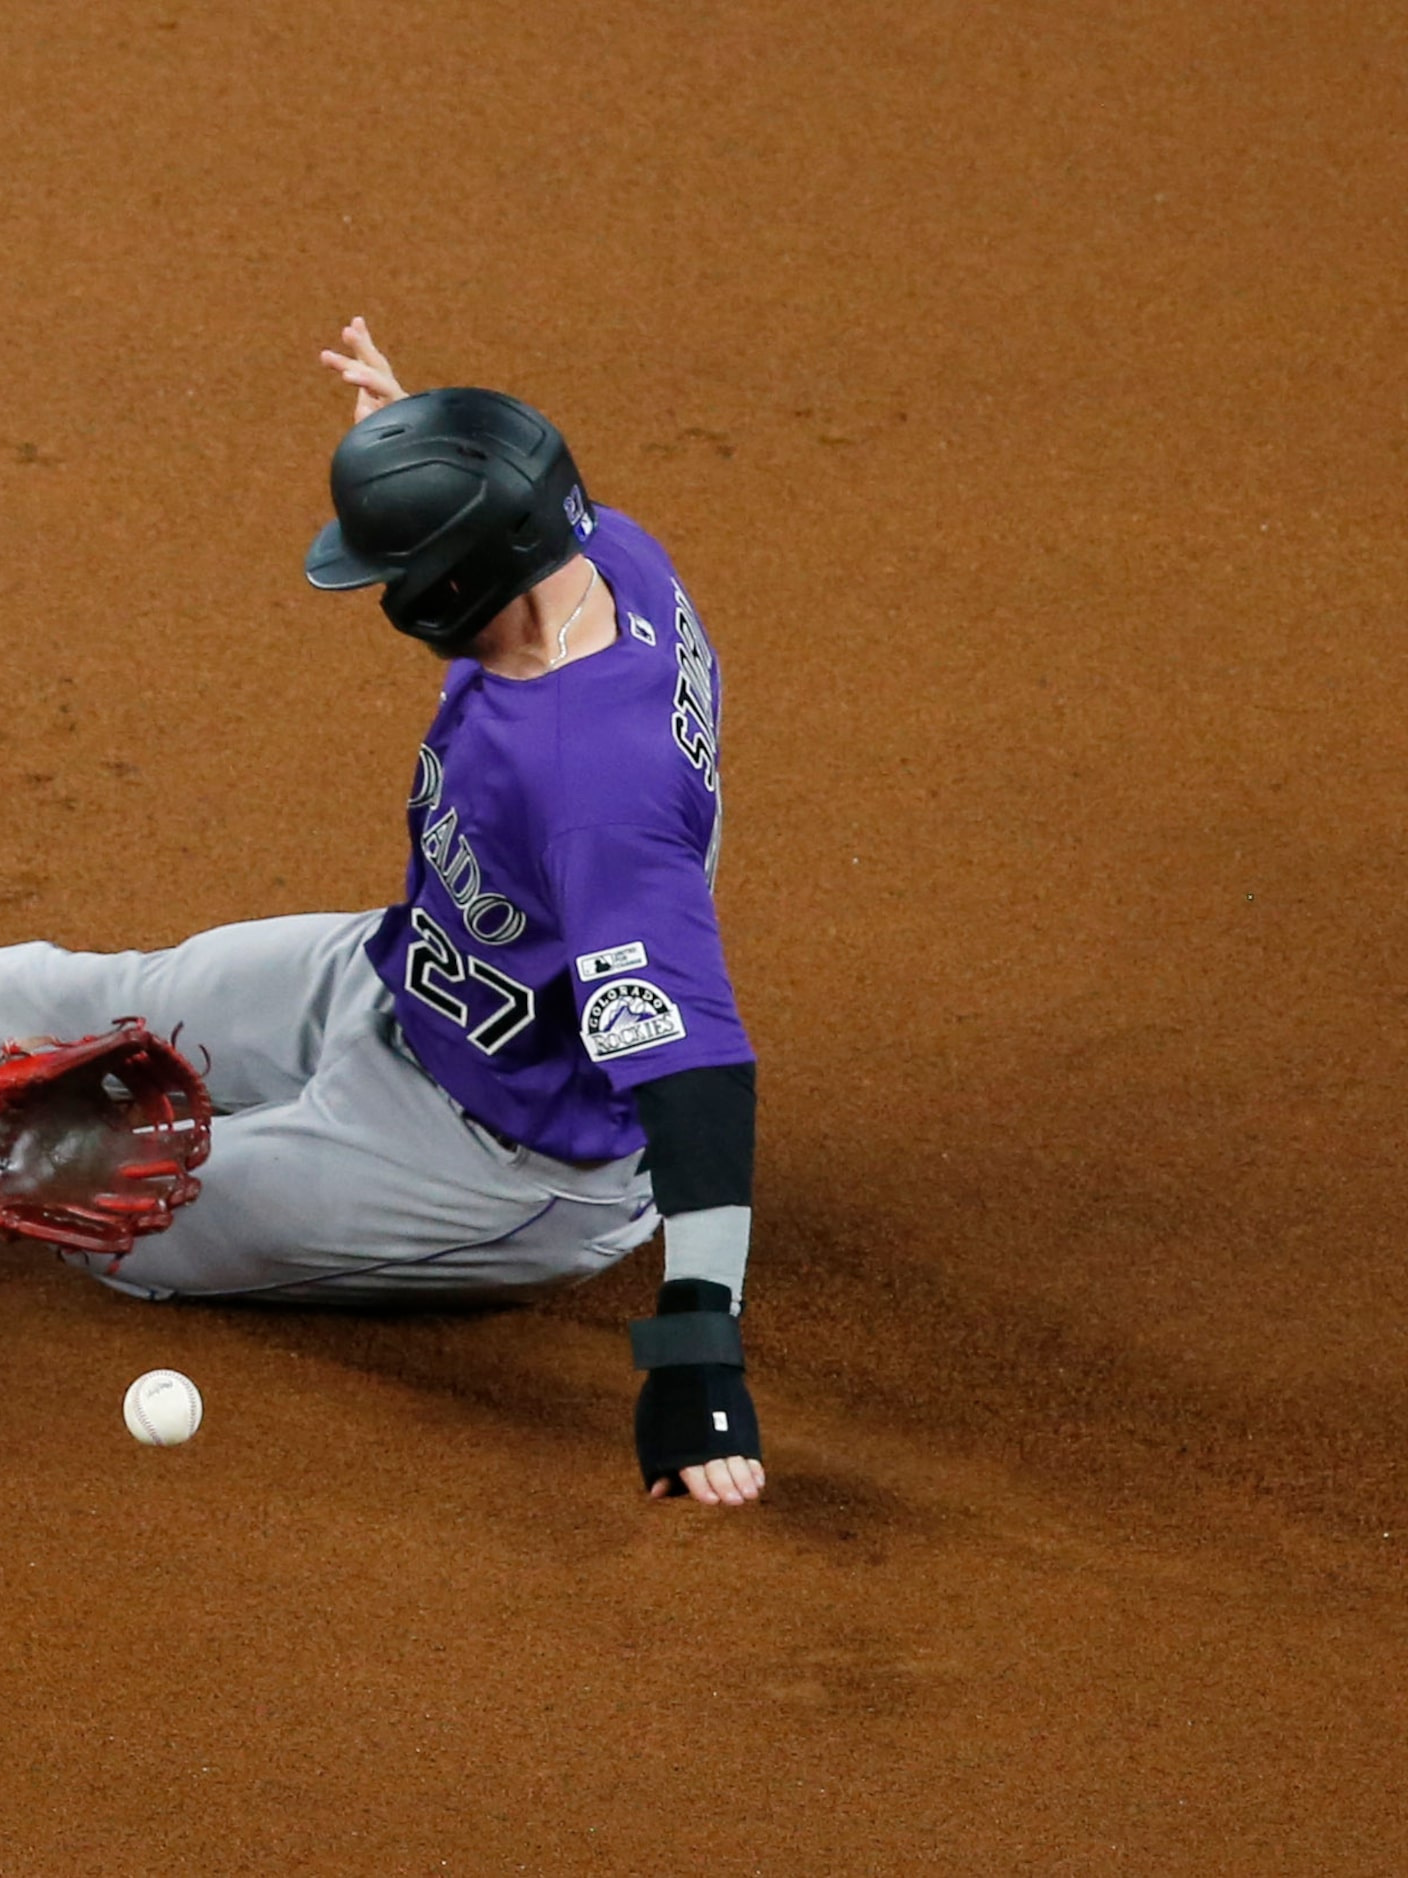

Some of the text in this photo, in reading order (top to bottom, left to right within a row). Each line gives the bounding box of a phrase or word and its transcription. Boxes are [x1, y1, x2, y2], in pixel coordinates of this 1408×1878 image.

[404, 907, 536, 1056] 27
[588, 985, 663, 1029] COLORADO
[591, 1015, 675, 1053] ROCKIES
